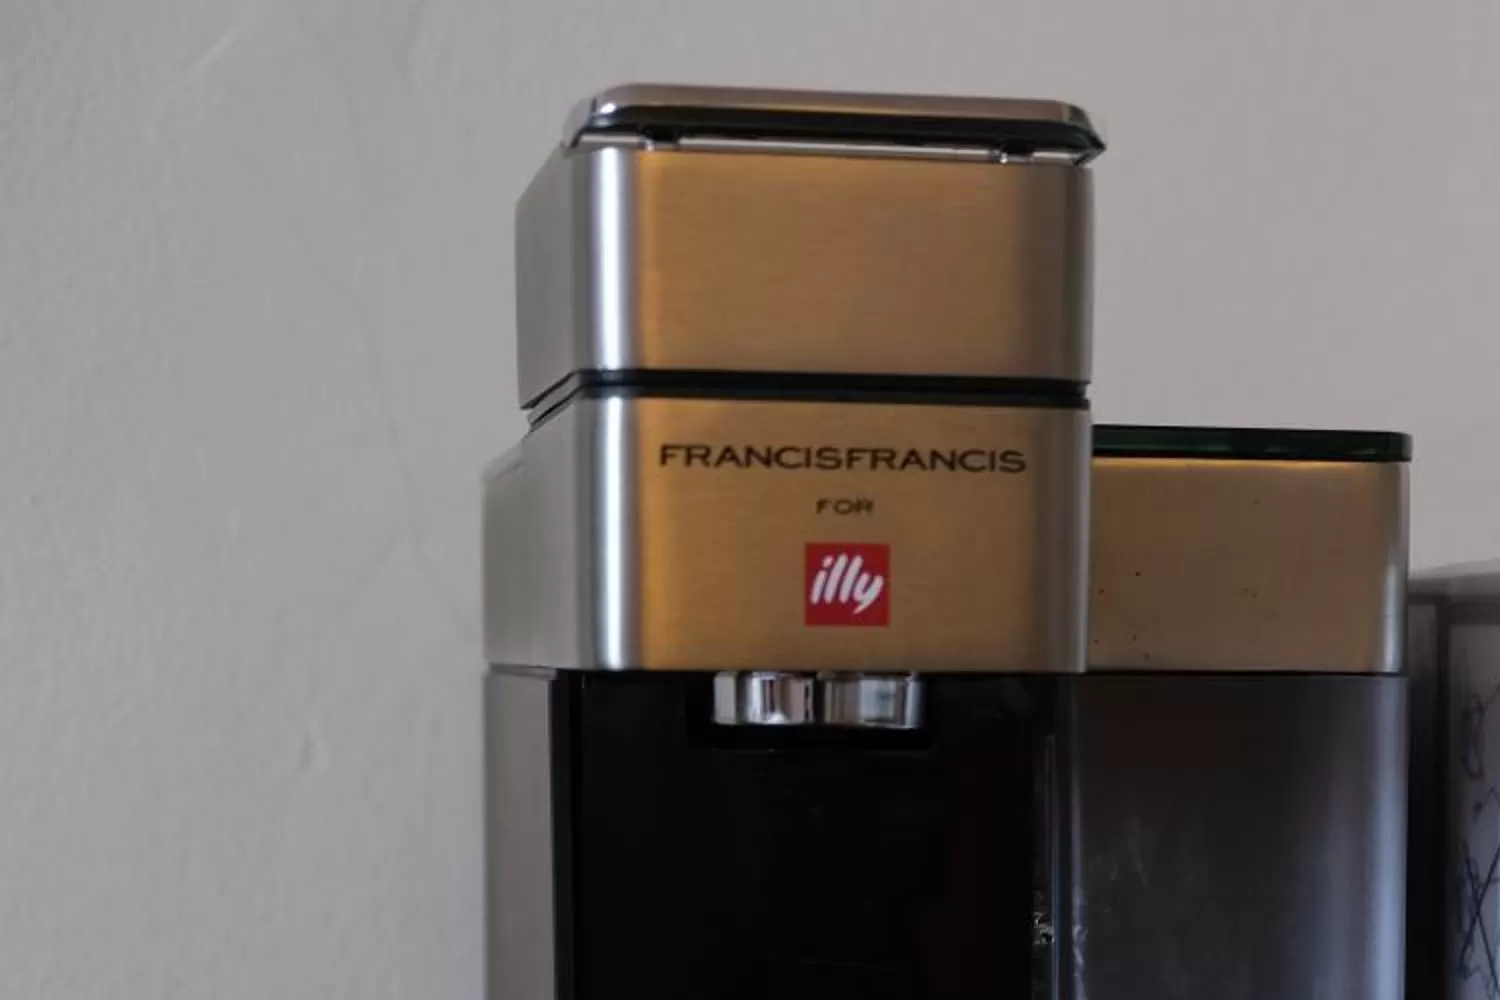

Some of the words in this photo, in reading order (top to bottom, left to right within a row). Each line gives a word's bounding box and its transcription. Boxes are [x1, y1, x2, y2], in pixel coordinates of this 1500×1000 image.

[659, 444, 1027, 474] FRANCISFRANCIS
[815, 497, 874, 516] FOR
[810, 553, 885, 615] illy
